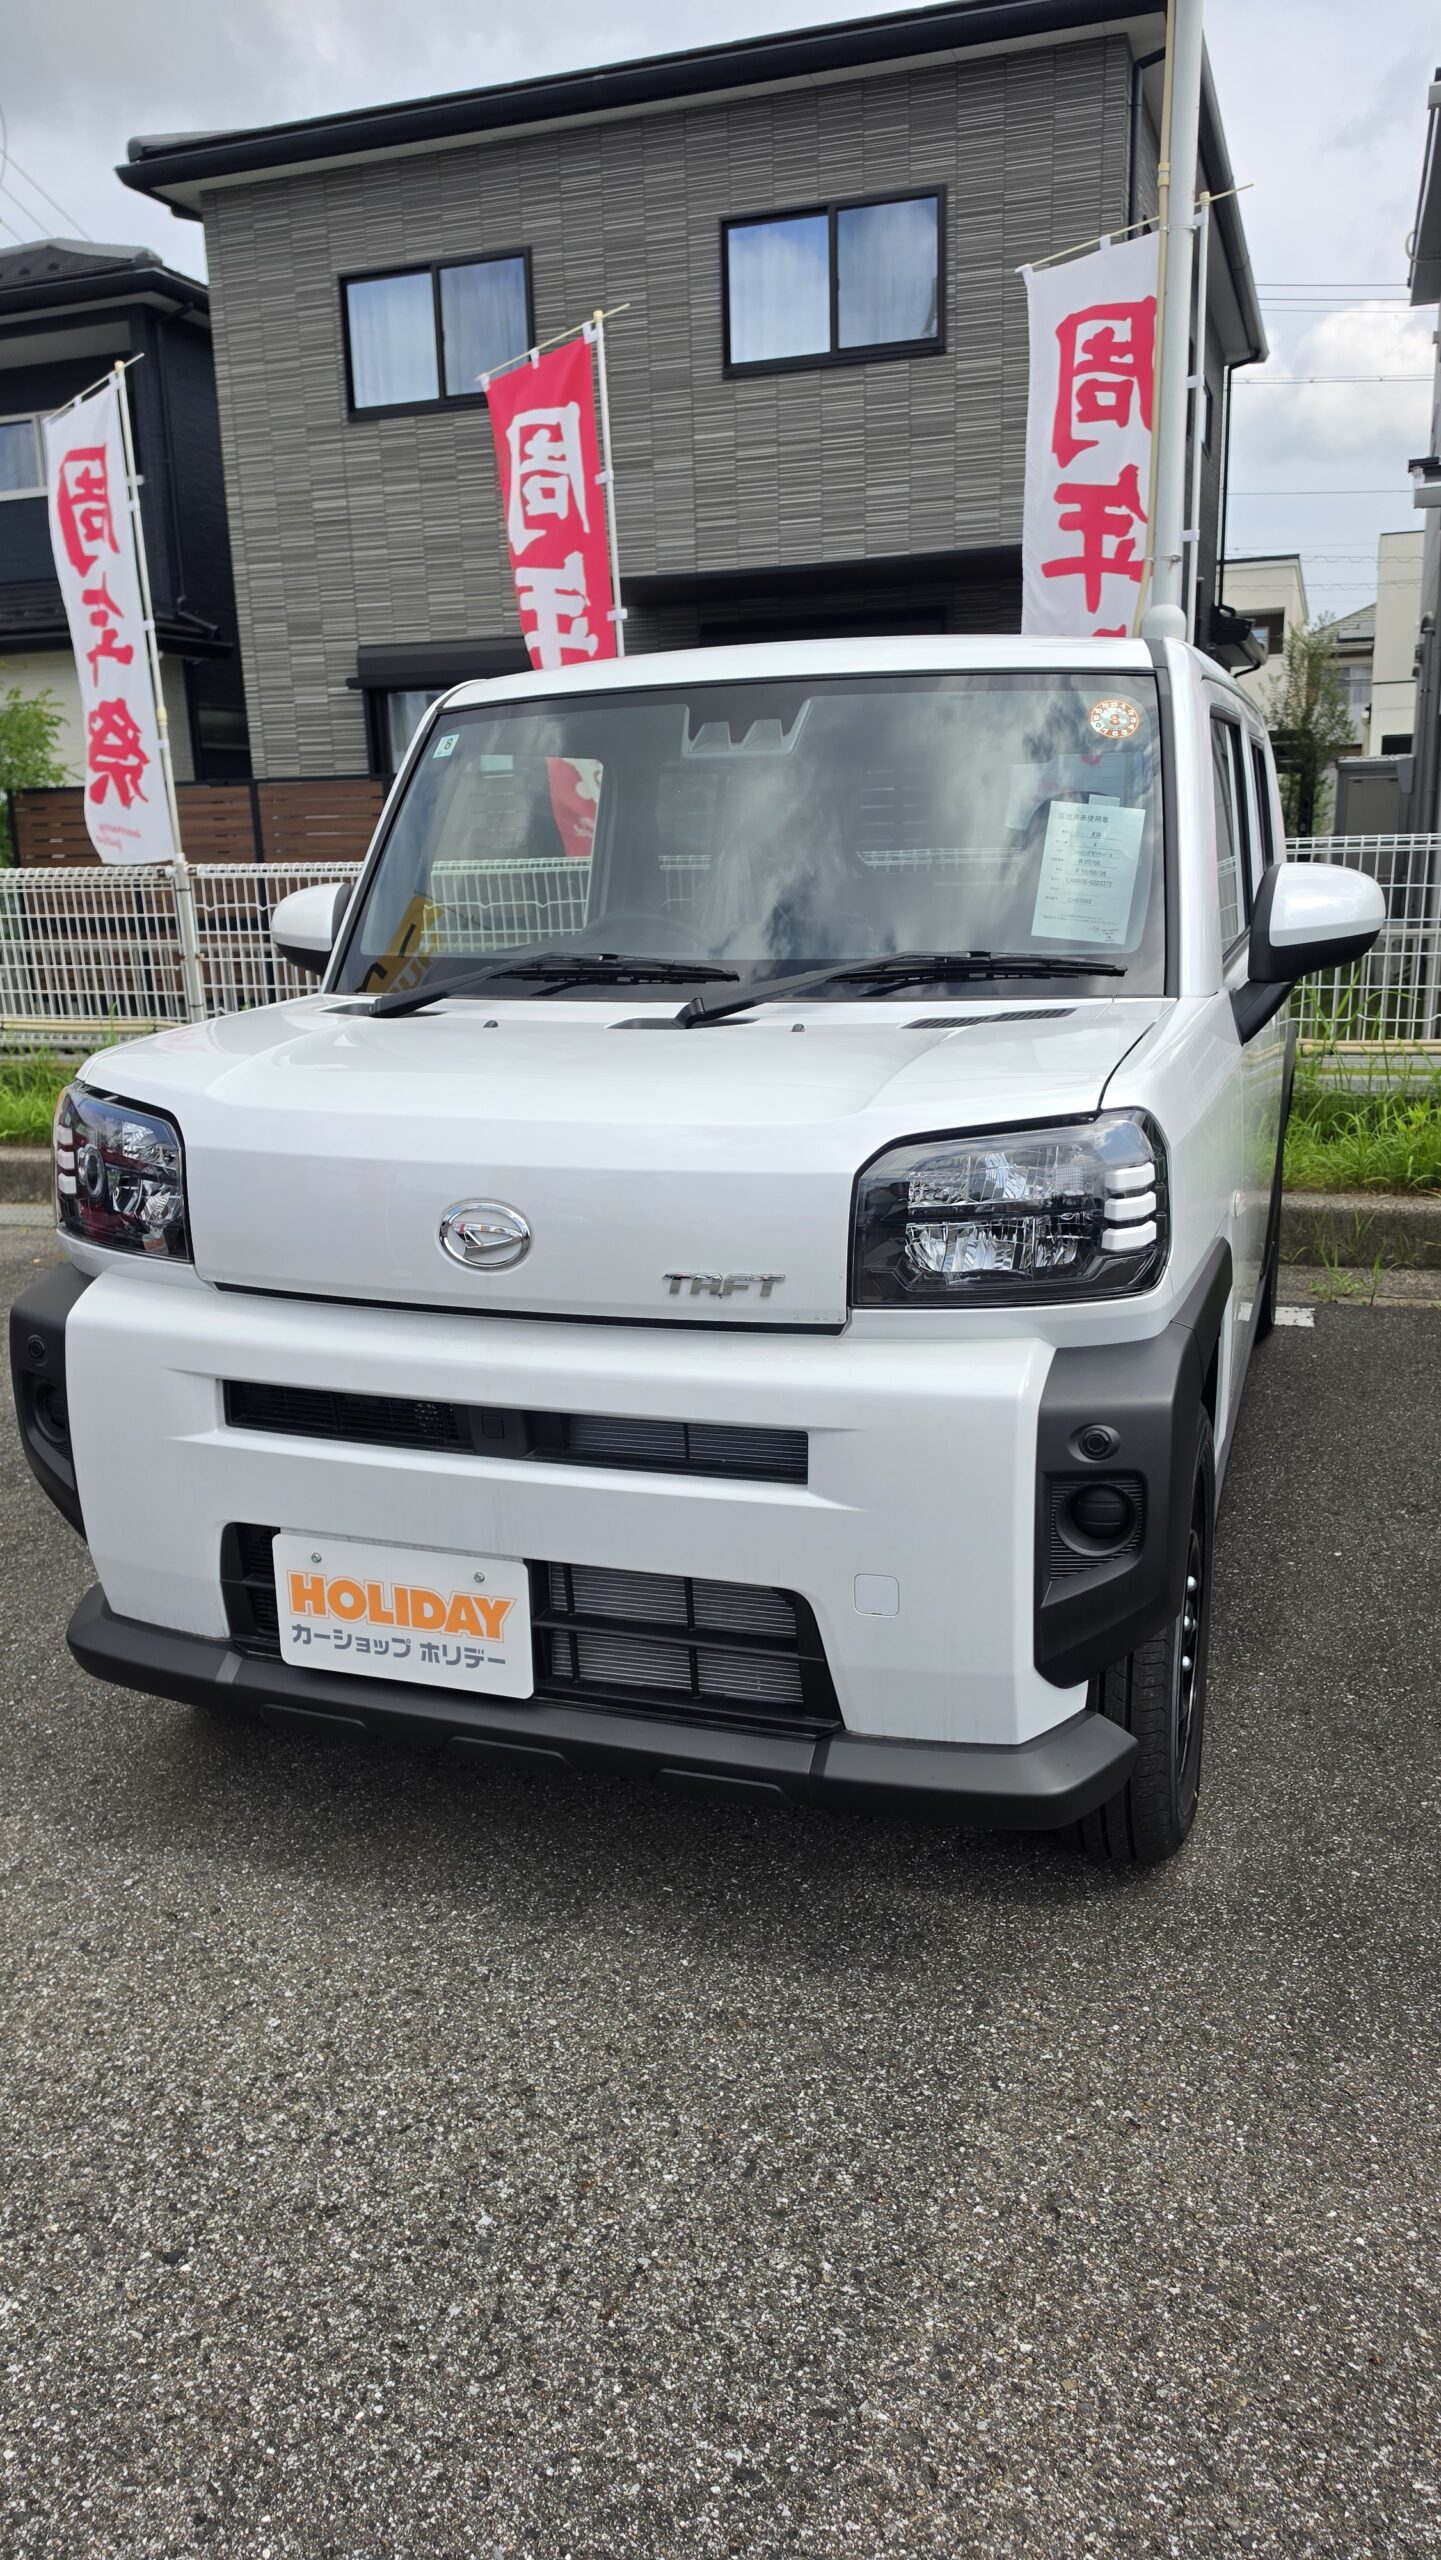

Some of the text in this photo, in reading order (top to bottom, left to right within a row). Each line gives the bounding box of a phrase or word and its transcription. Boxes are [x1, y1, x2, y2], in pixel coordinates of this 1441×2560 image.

[444, 737, 454, 750] 8
[662, 1271, 786, 1298] TAFT
[288, 1571, 515, 1642] HOLIDAY
[292, 1624, 506, 1669] カーショップ ホリデー
